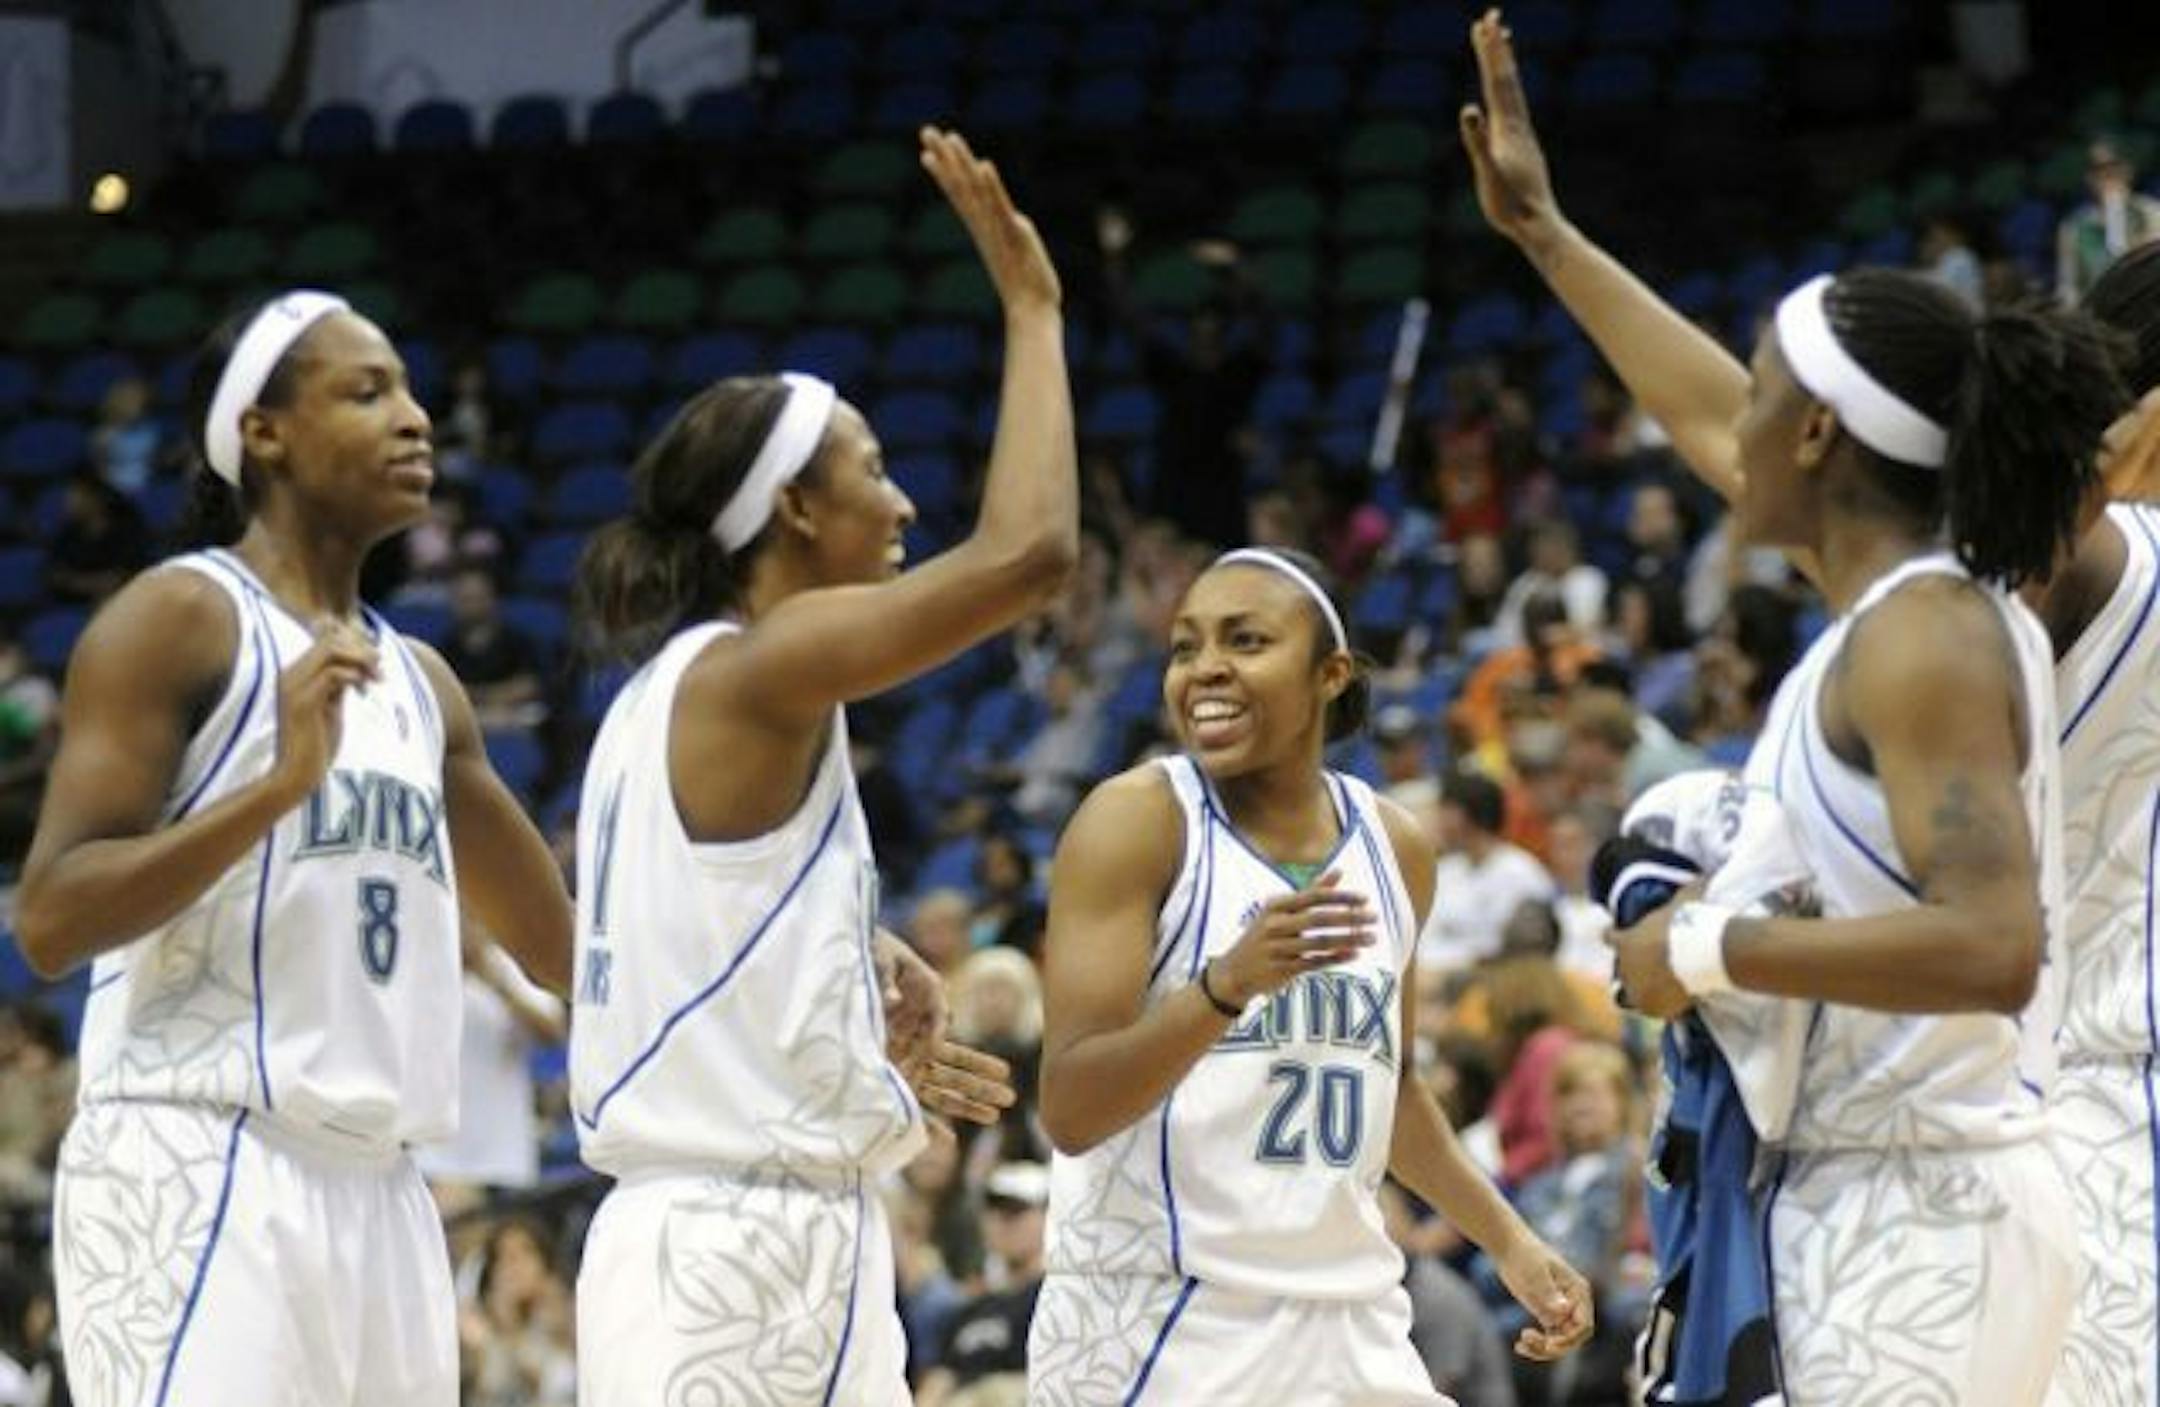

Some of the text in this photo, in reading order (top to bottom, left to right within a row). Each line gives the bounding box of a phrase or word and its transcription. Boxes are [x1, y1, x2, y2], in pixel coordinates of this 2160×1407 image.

[292, 769, 448, 887] LYNX
[358, 876, 399, 986] 8
[1256, 1059, 1365, 1168] 20
